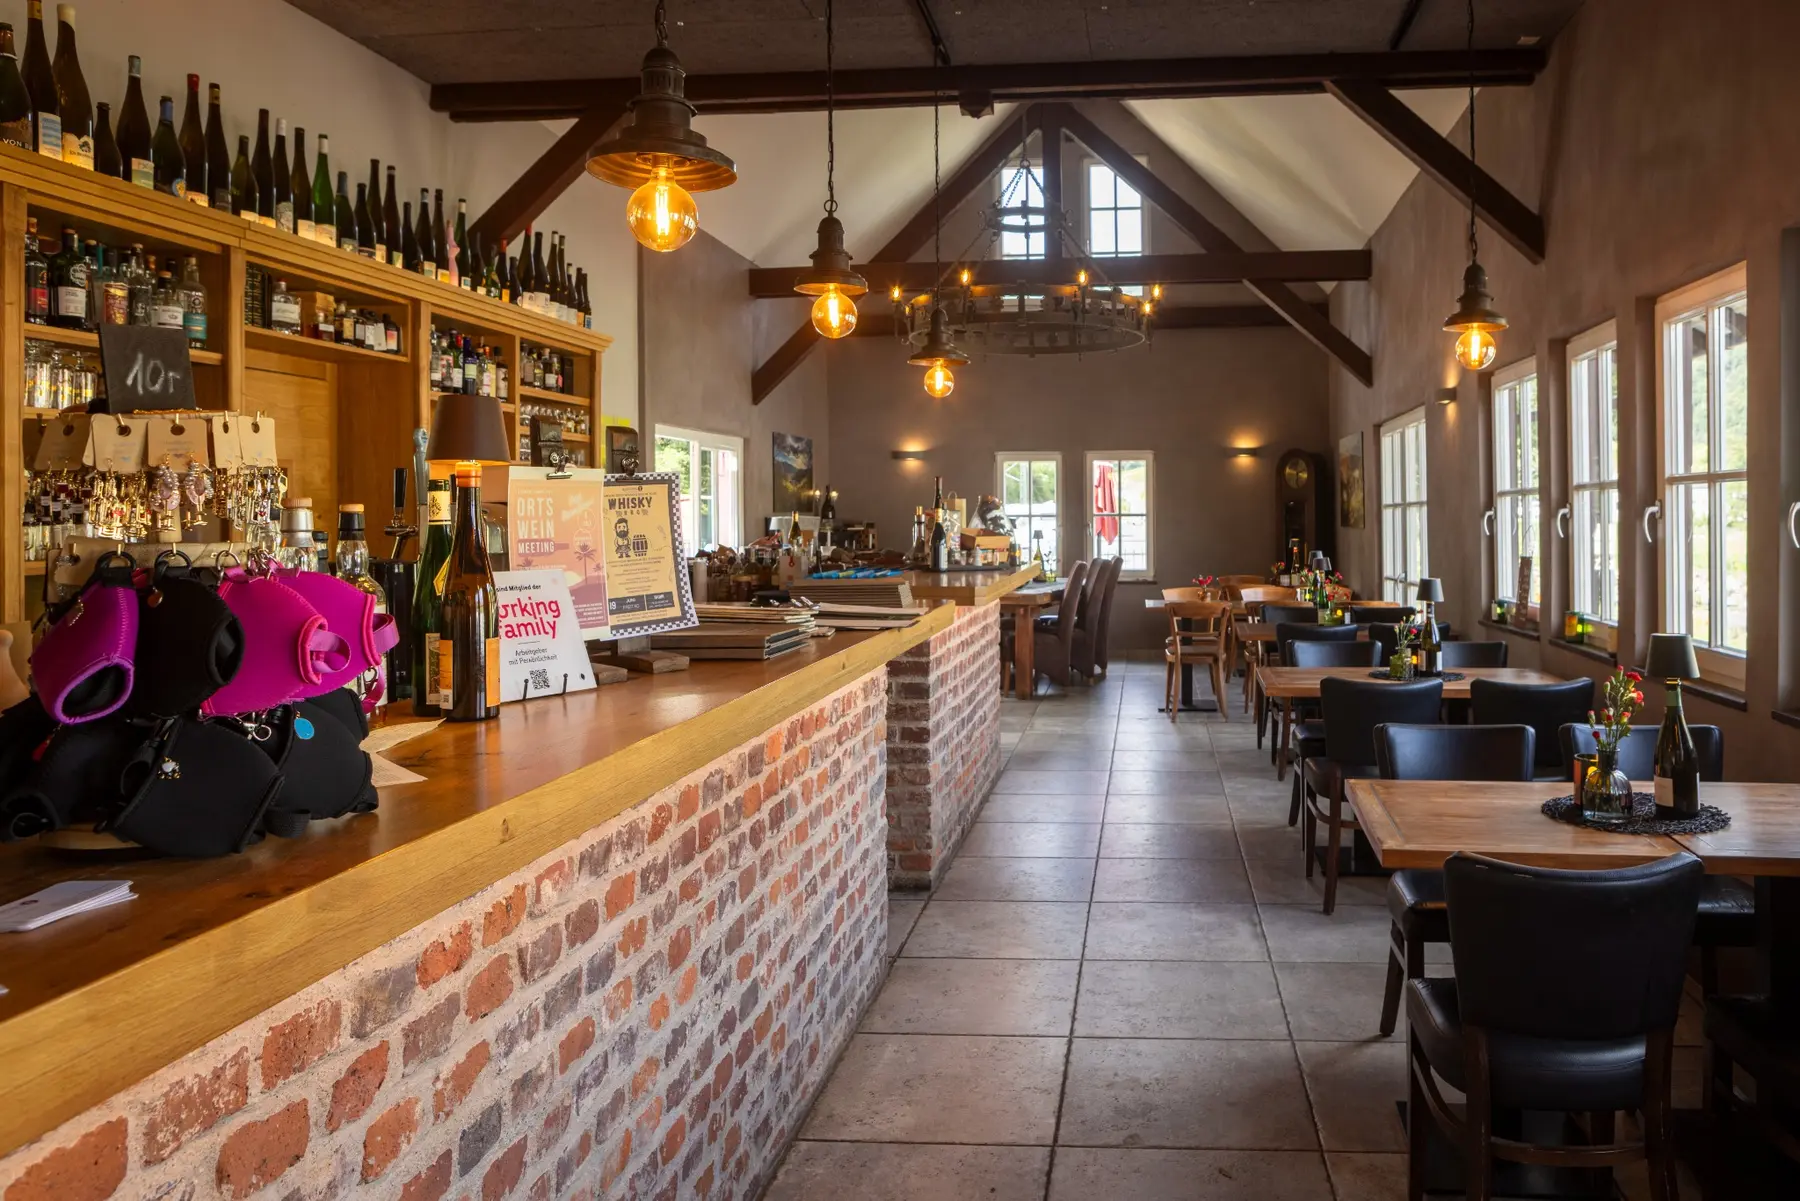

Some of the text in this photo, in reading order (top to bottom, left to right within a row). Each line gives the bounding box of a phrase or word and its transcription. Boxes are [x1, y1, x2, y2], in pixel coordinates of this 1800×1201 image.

[517, 497, 554, 517] ORTS
[607, 496, 653, 511] WHISKY
[517, 519, 555, 539] WEIN
[518, 541, 555, 554] MEETING
[509, 584, 532, 593] Mitglied
[499, 596, 561, 619] orking
[499, 617, 556, 639] amily
[508, 658, 519, 666] mit
